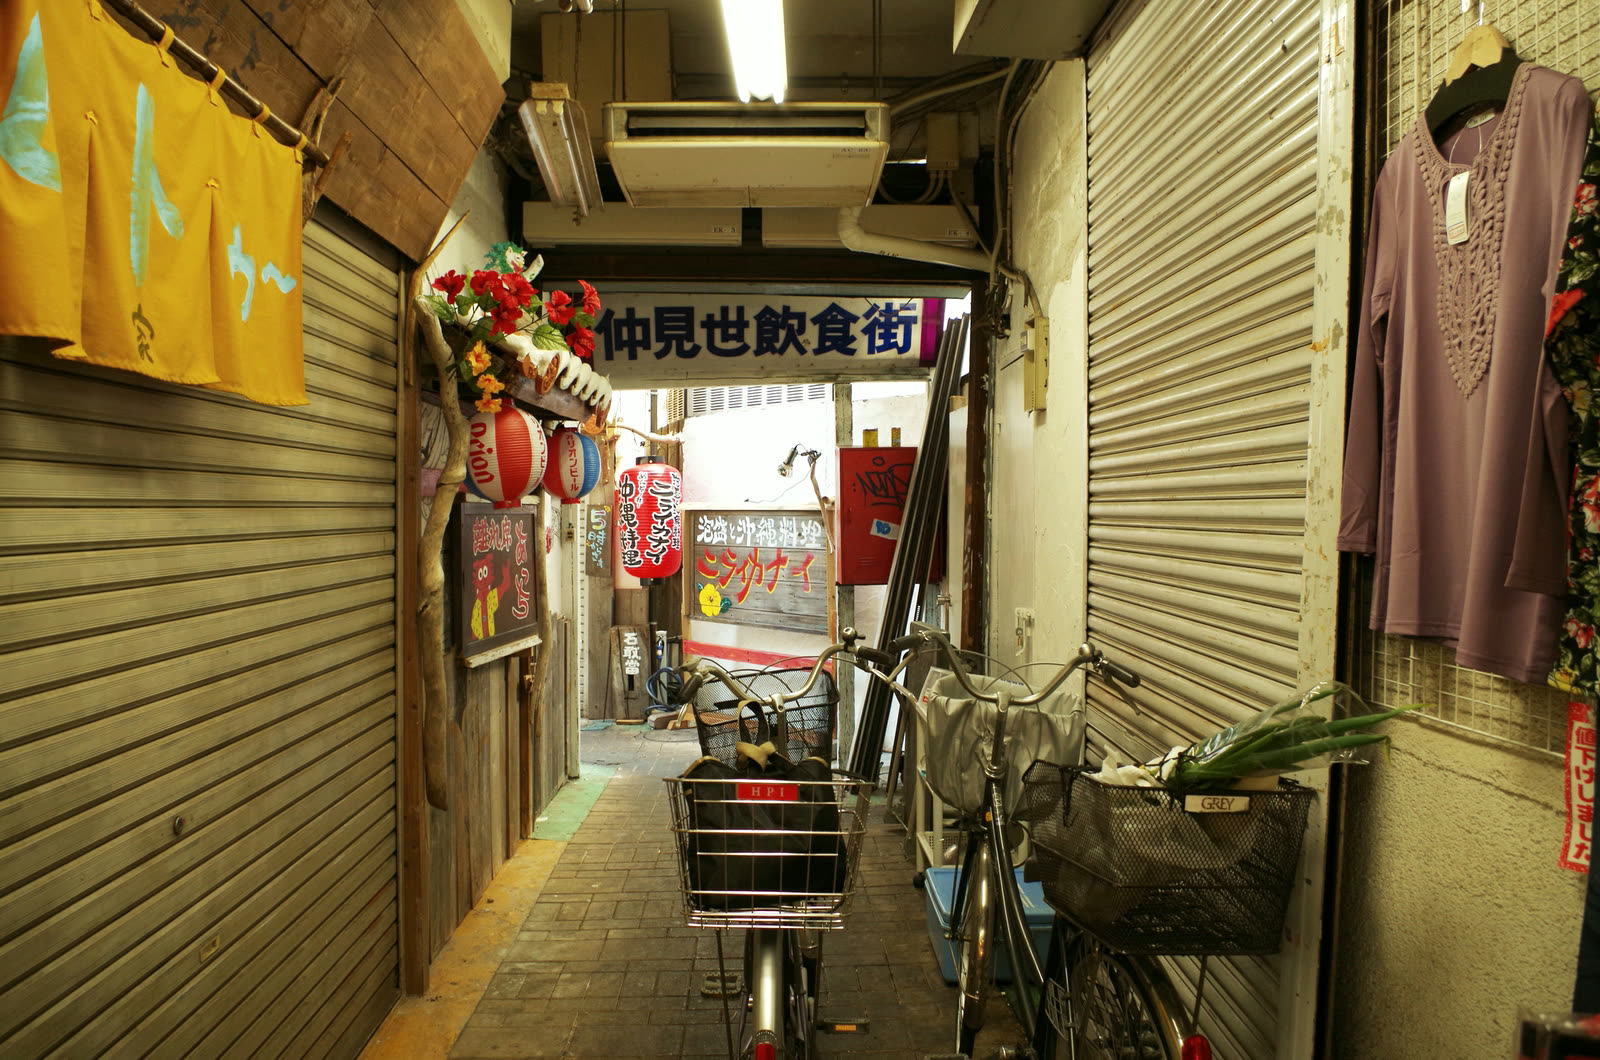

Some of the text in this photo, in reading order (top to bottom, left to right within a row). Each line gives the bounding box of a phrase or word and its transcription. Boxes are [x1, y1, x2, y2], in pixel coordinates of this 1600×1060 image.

[595, 302, 918, 361] 仲見世飲食街
[469, 421, 495, 485] Orion
[565, 433, 580, 492] オリオンビール
[645, 480, 674, 566] ニライカナイ
[696, 514, 822, 548] 泡盛と沖縄料理
[695, 546, 817, 605] ニライカナイ
[622, 632, 641, 675] 石敢當
[1201, 796, 1236, 811] GREY
